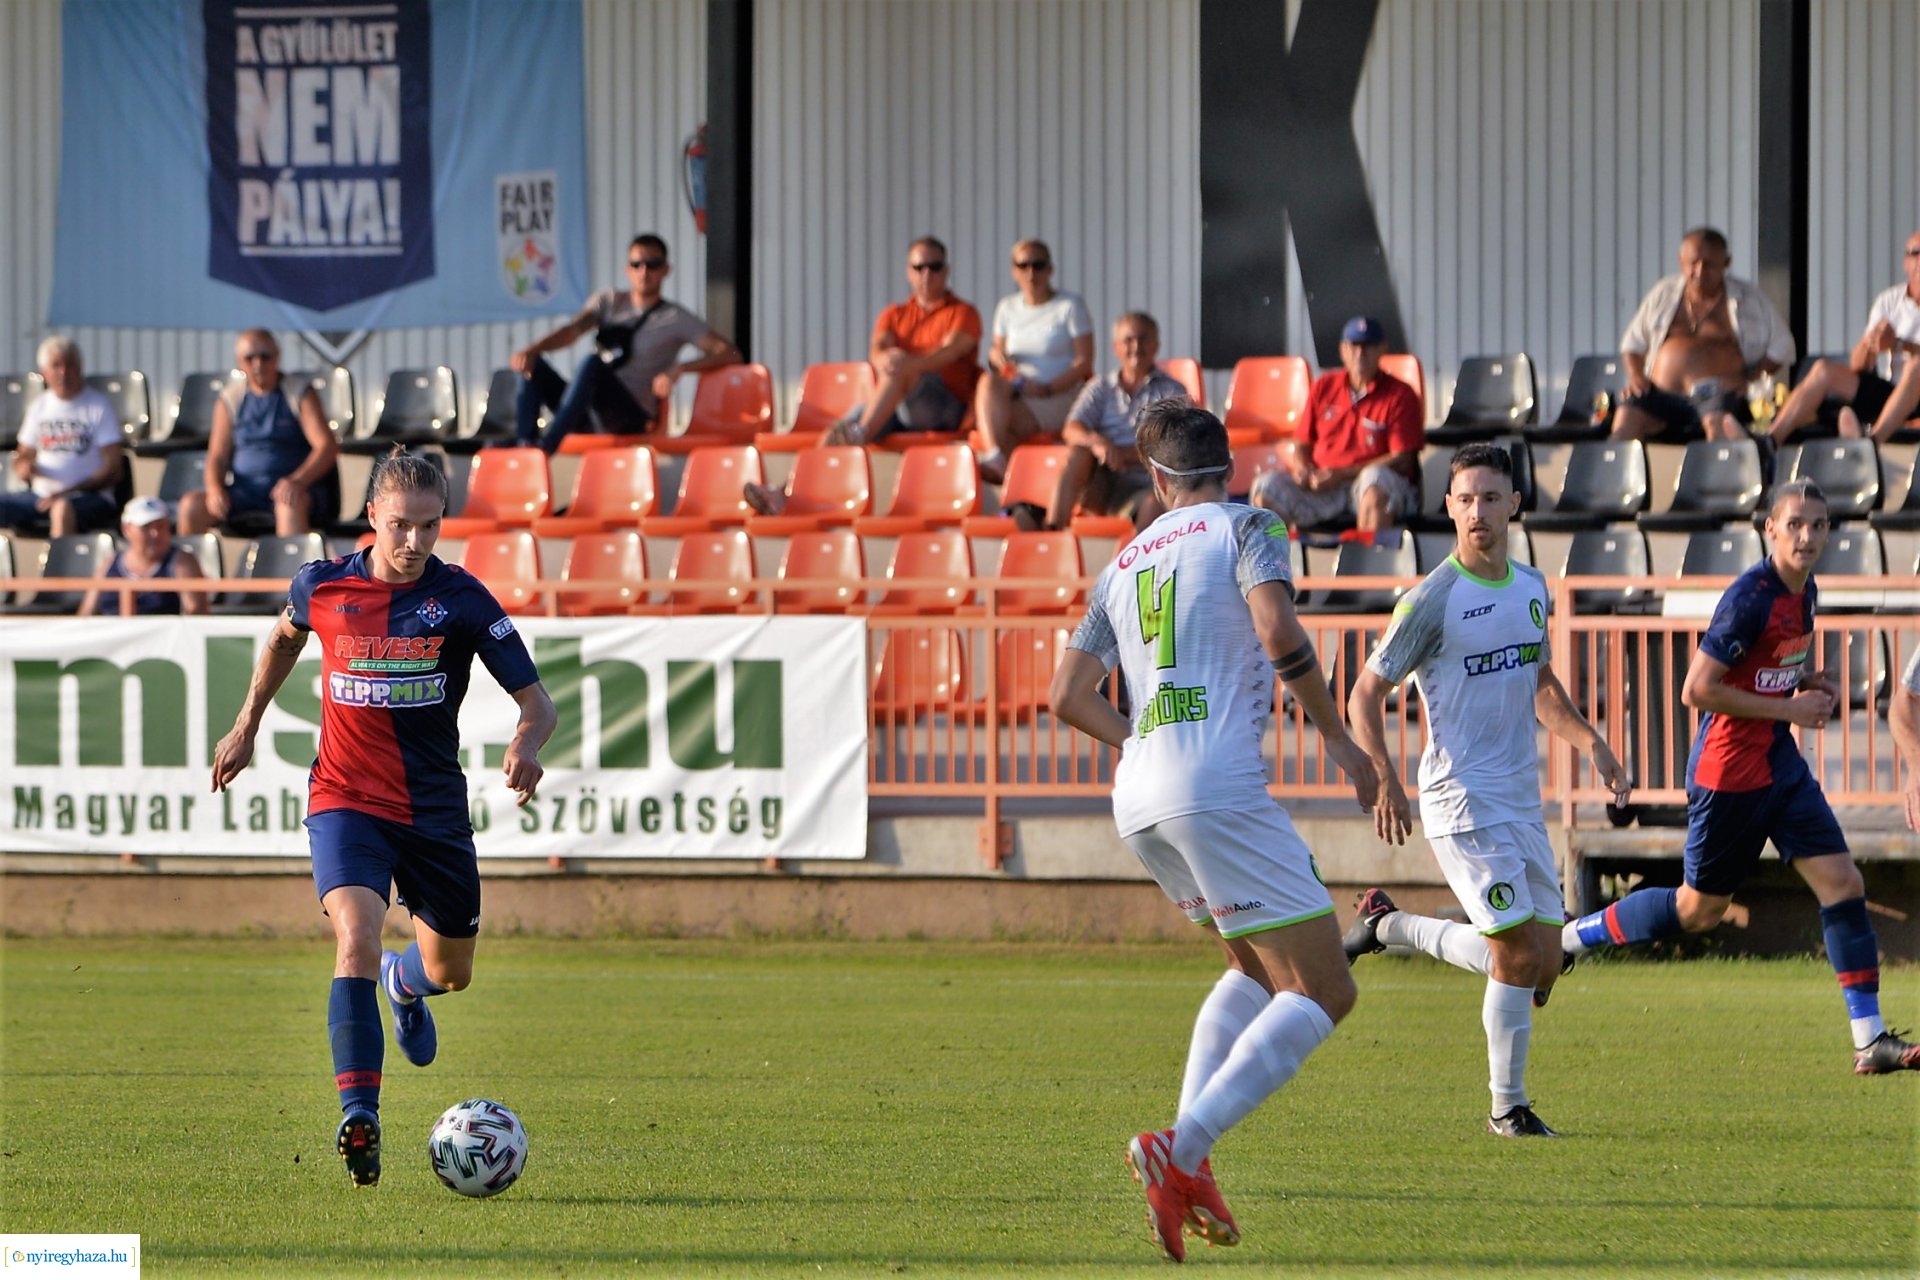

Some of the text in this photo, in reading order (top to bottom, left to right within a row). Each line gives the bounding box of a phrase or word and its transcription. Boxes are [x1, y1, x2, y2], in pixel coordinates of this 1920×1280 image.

[236, 25, 259, 63] A
[236, 66, 400, 166] NEM
[238, 168, 402, 244] PÁLYA!
[501, 180, 554, 206] FAIR
[501, 209, 553, 235] PLAY
[1142, 521, 1207, 554] VEOLIA
[1137, 565, 1176, 669] 4
[350, 661, 376, 669] ALWAYS
[13, 637, 783, 770] mls.hu
[13, 785, 196, 835] Magyar
[520, 786, 783, 839] Szövetség
[1177, 896, 1207, 910] EOLIA
